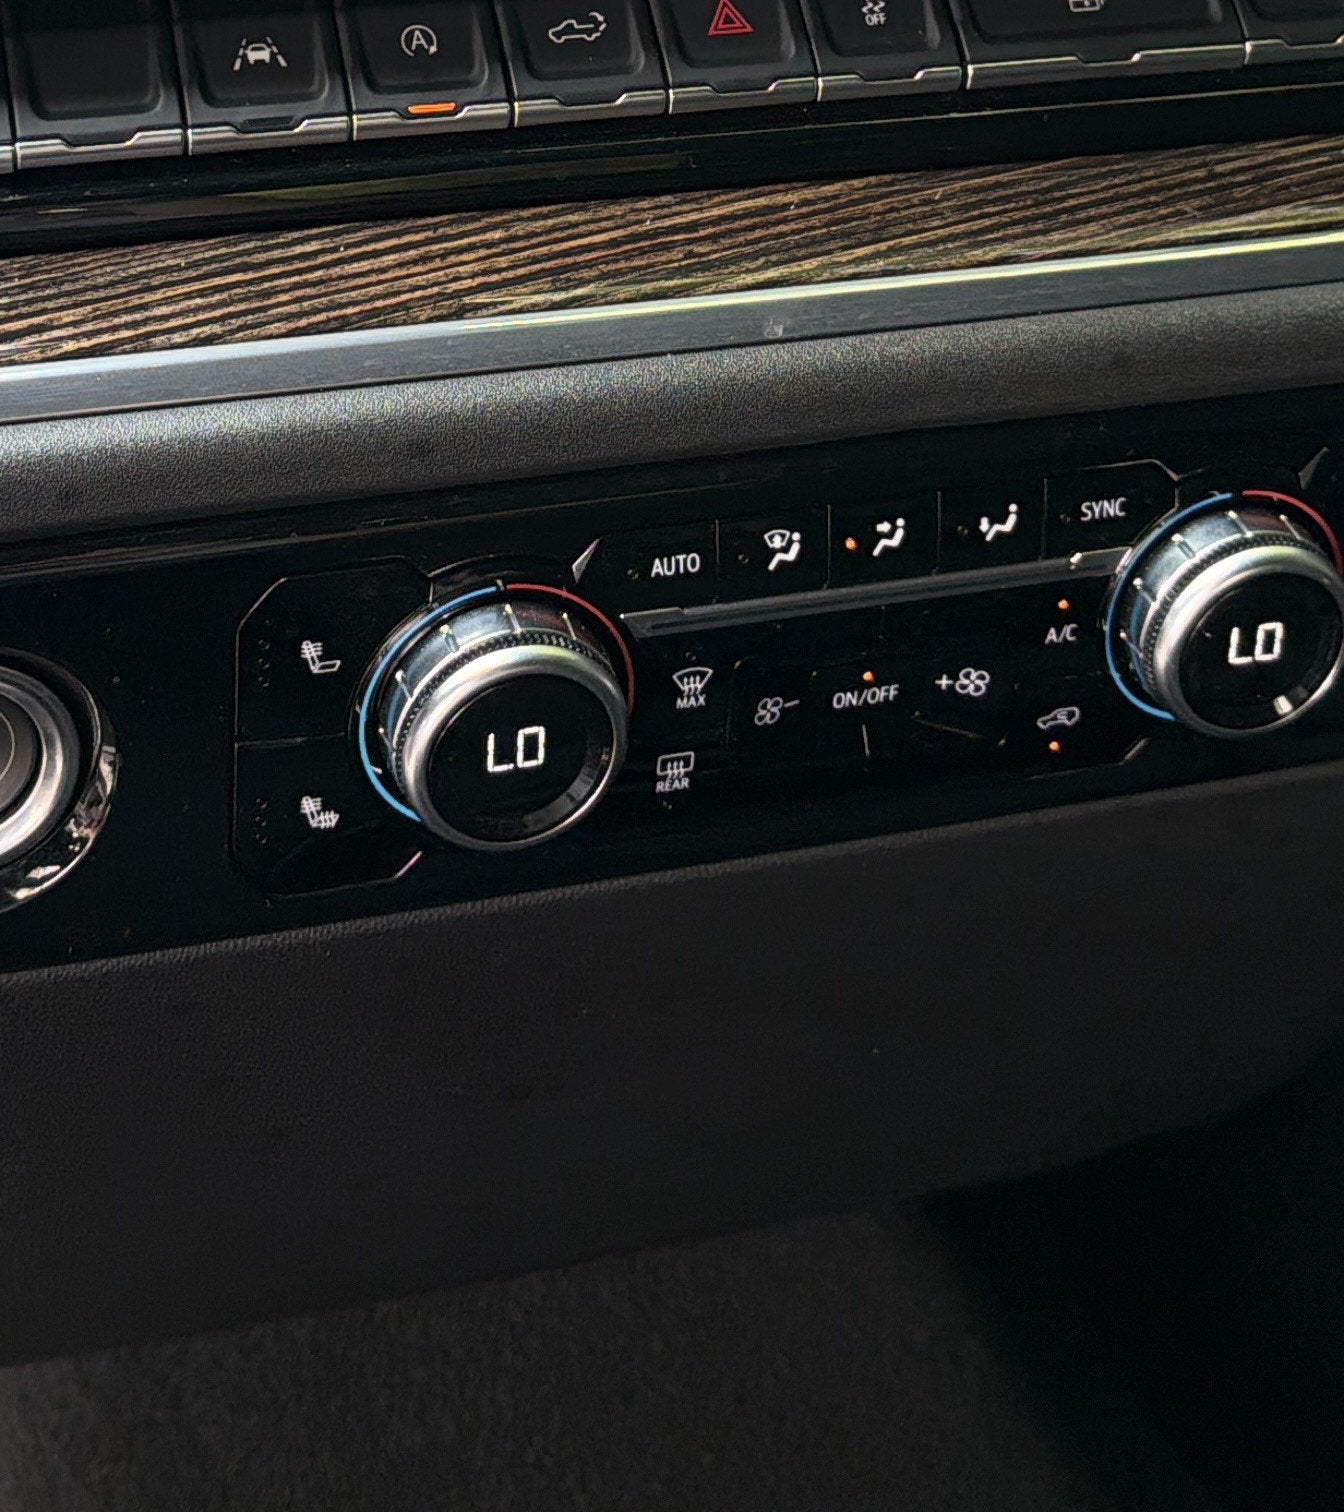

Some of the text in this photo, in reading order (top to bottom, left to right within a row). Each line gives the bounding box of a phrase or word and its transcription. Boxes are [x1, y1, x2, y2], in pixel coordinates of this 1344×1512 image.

[864, 13, 887, 26] OFF
[1080, 497, 1127, 522] SYNC
[651, 553, 701, 578] AUTO
[1044, 623, 1079, 645] A/C
[1228, 621, 1283, 665] LO
[676, 693, 707, 709] MAX
[832, 684, 900, 711] ON/OFF
[486, 724, 545, 774] LO
[656, 776, 691, 792] REAR
